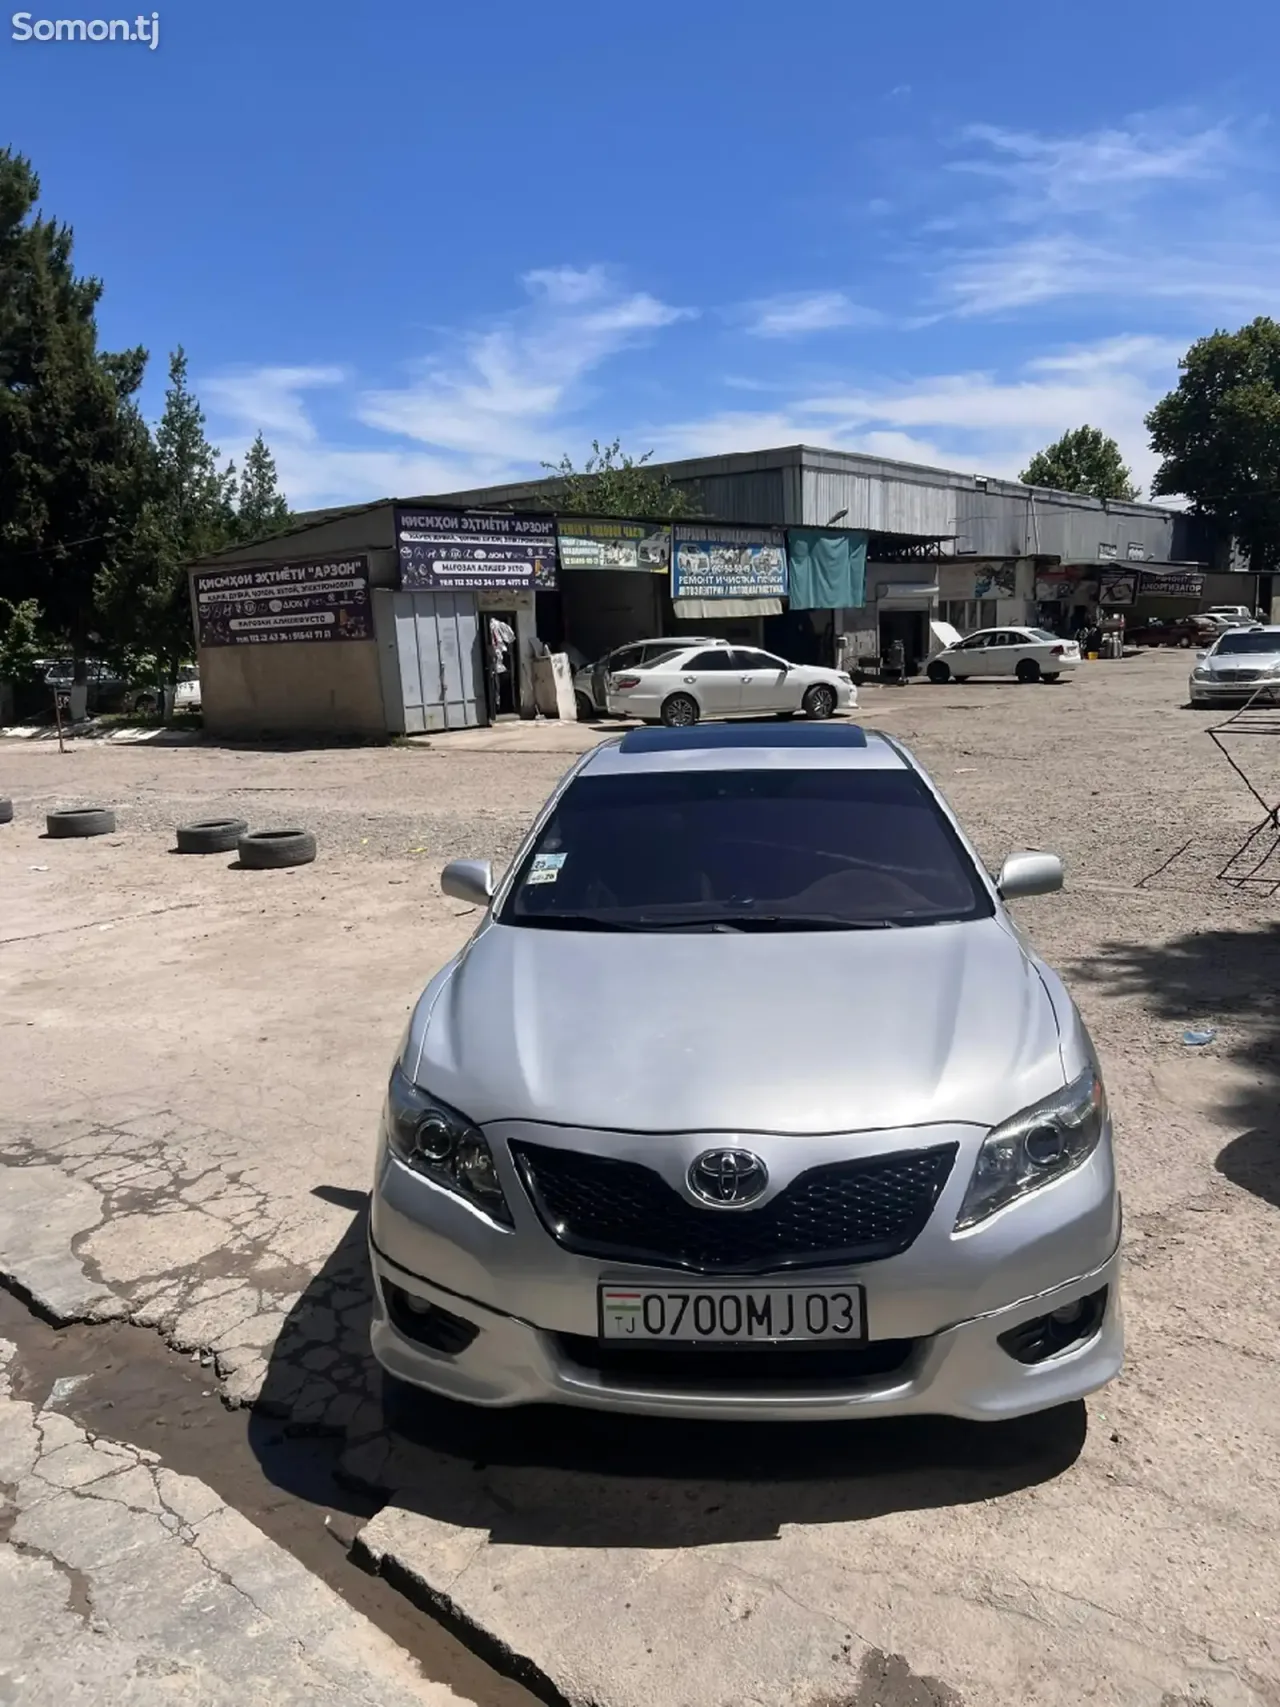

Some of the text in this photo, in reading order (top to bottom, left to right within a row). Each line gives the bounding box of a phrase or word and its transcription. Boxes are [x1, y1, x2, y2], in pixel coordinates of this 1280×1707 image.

[511, 522, 553, 533] "АРЗОН"
[308, 561, 361, 580] "АРЗОН"
[678, 575, 714, 585] РЕМОНТ
